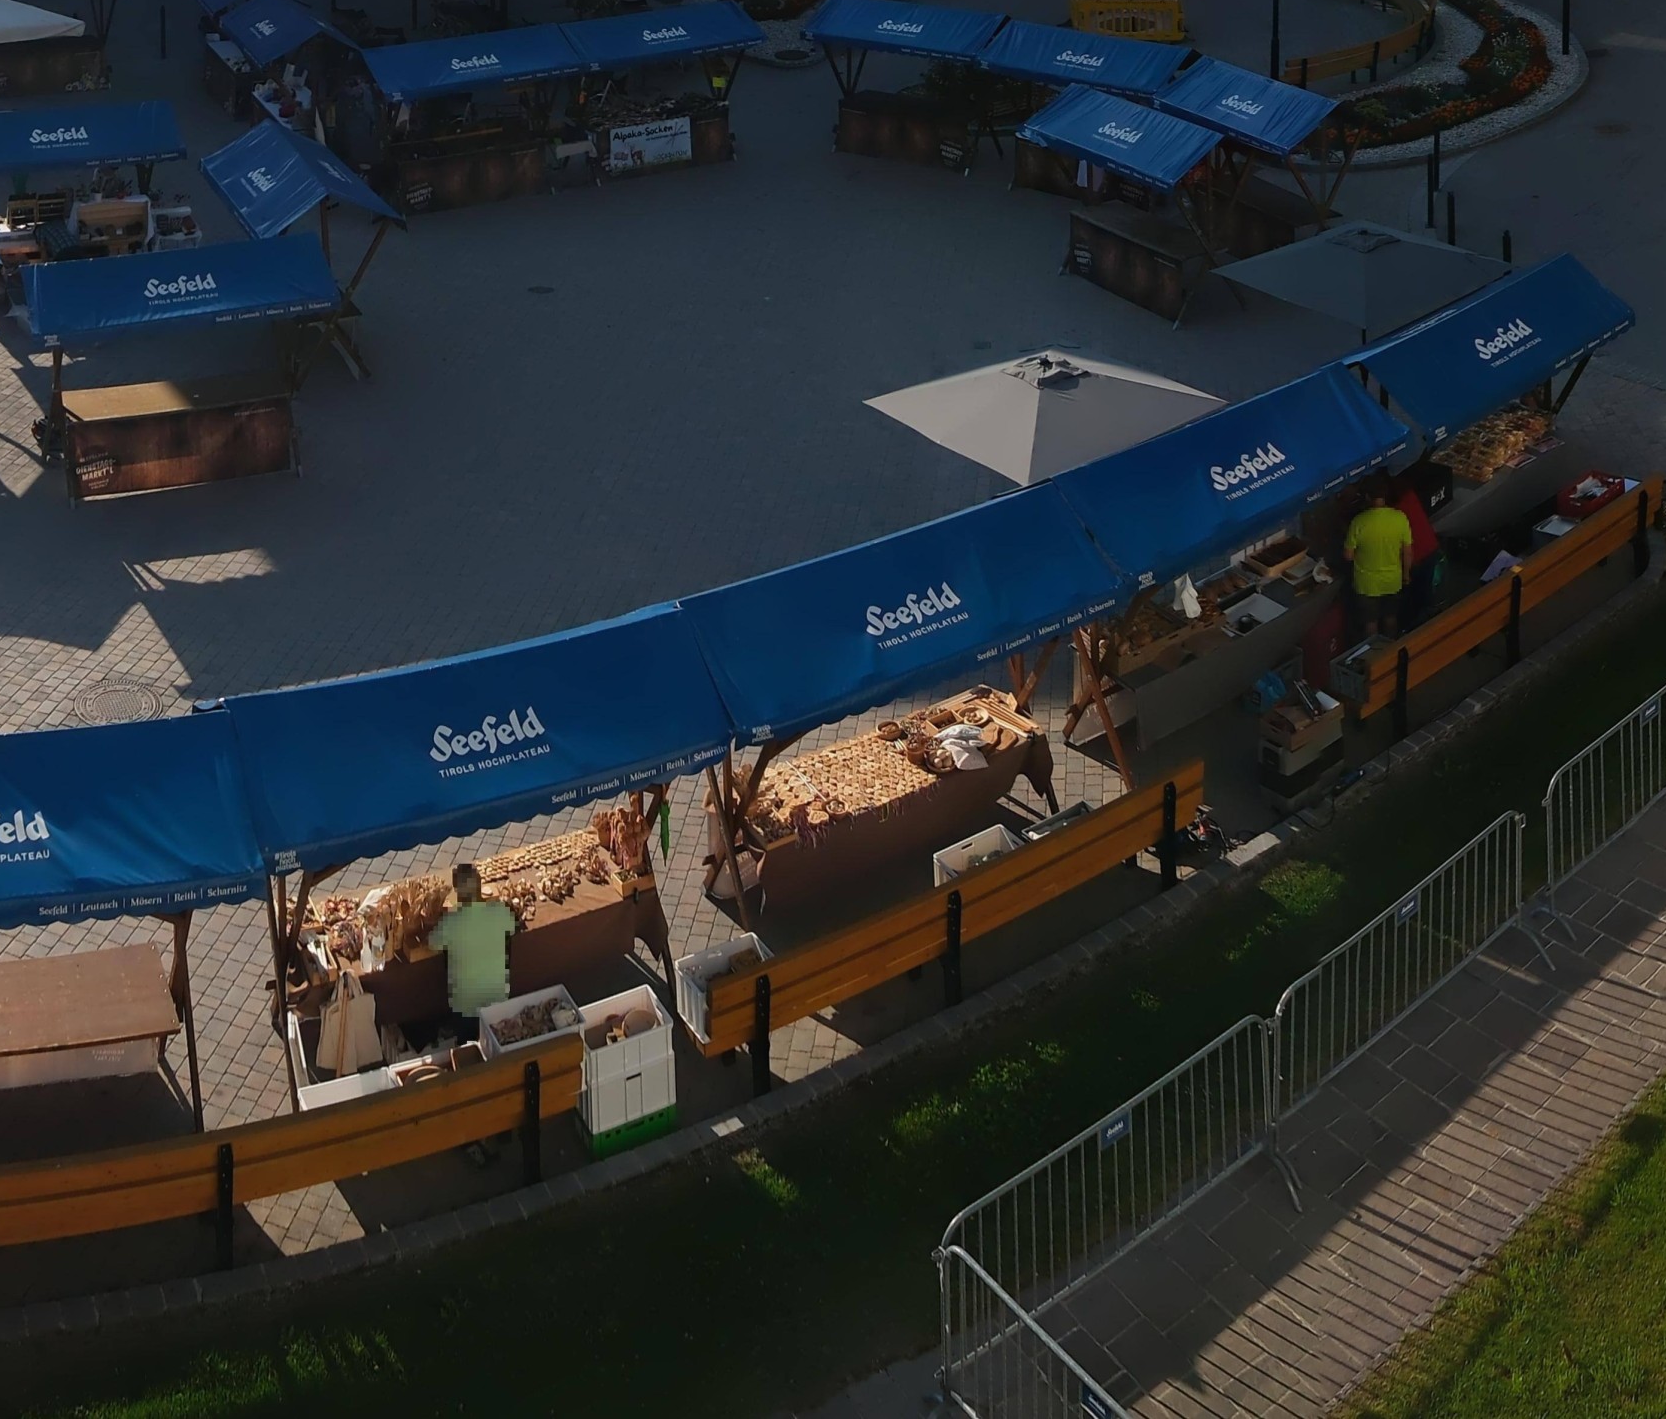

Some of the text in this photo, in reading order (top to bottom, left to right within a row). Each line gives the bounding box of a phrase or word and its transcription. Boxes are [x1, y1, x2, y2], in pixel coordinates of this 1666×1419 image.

[642, 26, 687, 42] Seefeld
[877, 19, 923, 33] Seefeld
[451, 54, 499, 70] Seefeld
[1056, 49, 1105, 68] Seefeld
[1221, 94, 1264, 116] Seefeld
[29, 126, 88, 144] Seefeld
[1098, 121, 1143, 145] Seefeld
[144, 273, 217, 298] Seefeld
[1474, 318, 1533, 360] Seefeld
[1210, 441, 1286, 492] Seefeld
[866, 581, 961, 637] Seefeld
[877, 611, 969, 650] TIROLS HOCHPLATEAU
[430, 705, 545, 762] Seefeld
[438, 743, 551, 779] TIROLS HOCHPLATEAU
[551, 744, 729, 804] Seefeld Leutasch Mösern Reith Scharnitz
[39, 883, 247, 916] Seefeld Leutasch Mösern Reith Scharnitz
